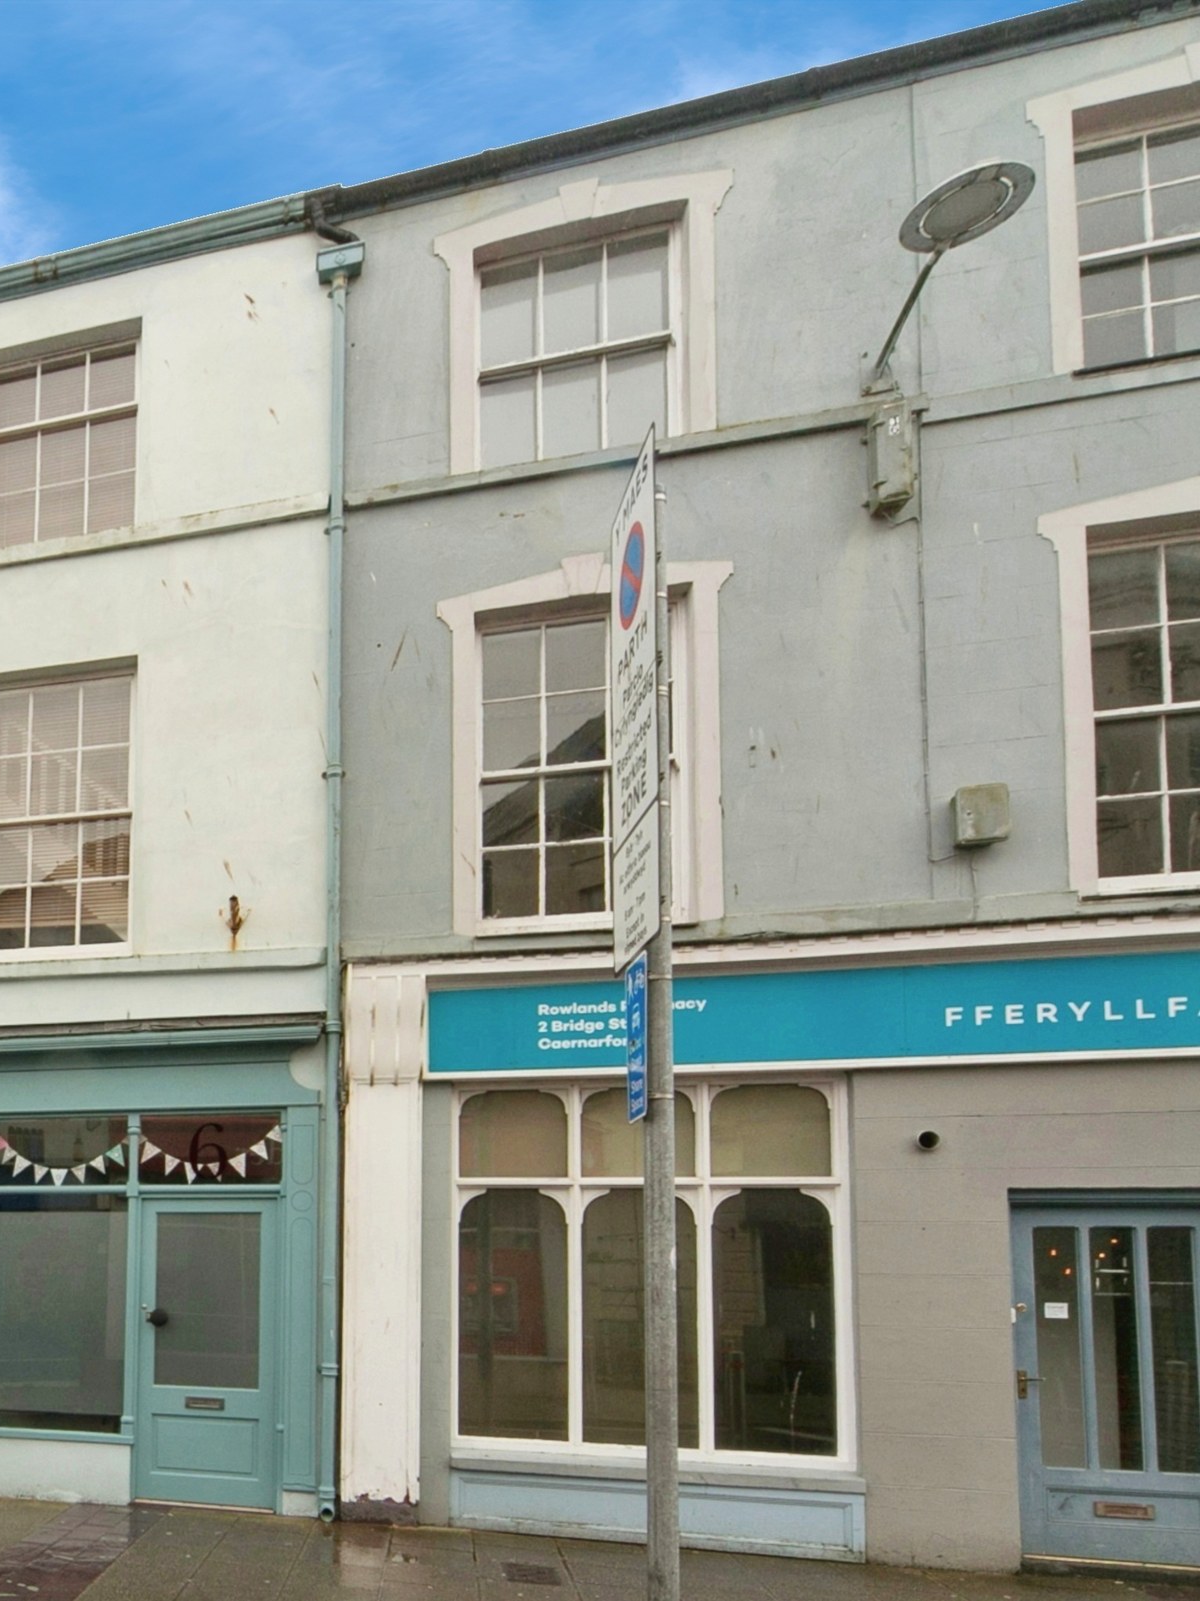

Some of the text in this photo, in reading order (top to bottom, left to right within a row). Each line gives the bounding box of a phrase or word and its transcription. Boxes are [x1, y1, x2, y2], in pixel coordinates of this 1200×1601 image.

[615, 453, 649, 546] Y MAES
[617, 616, 647, 684] PARTH
[622, 663, 644, 708] Parcio
[617, 708, 652, 780] Restricted
[620, 748, 647, 797] Parking
[621, 771, 647, 828] ZONE
[537, 1001, 617, 1016] Rowlands
[537, 1020, 548, 1033] 2
[551, 1017, 605, 1034] Bridge
[945, 996, 1200, 1027] FFERYLLF
[190, 1122, 227, 1178] 6
